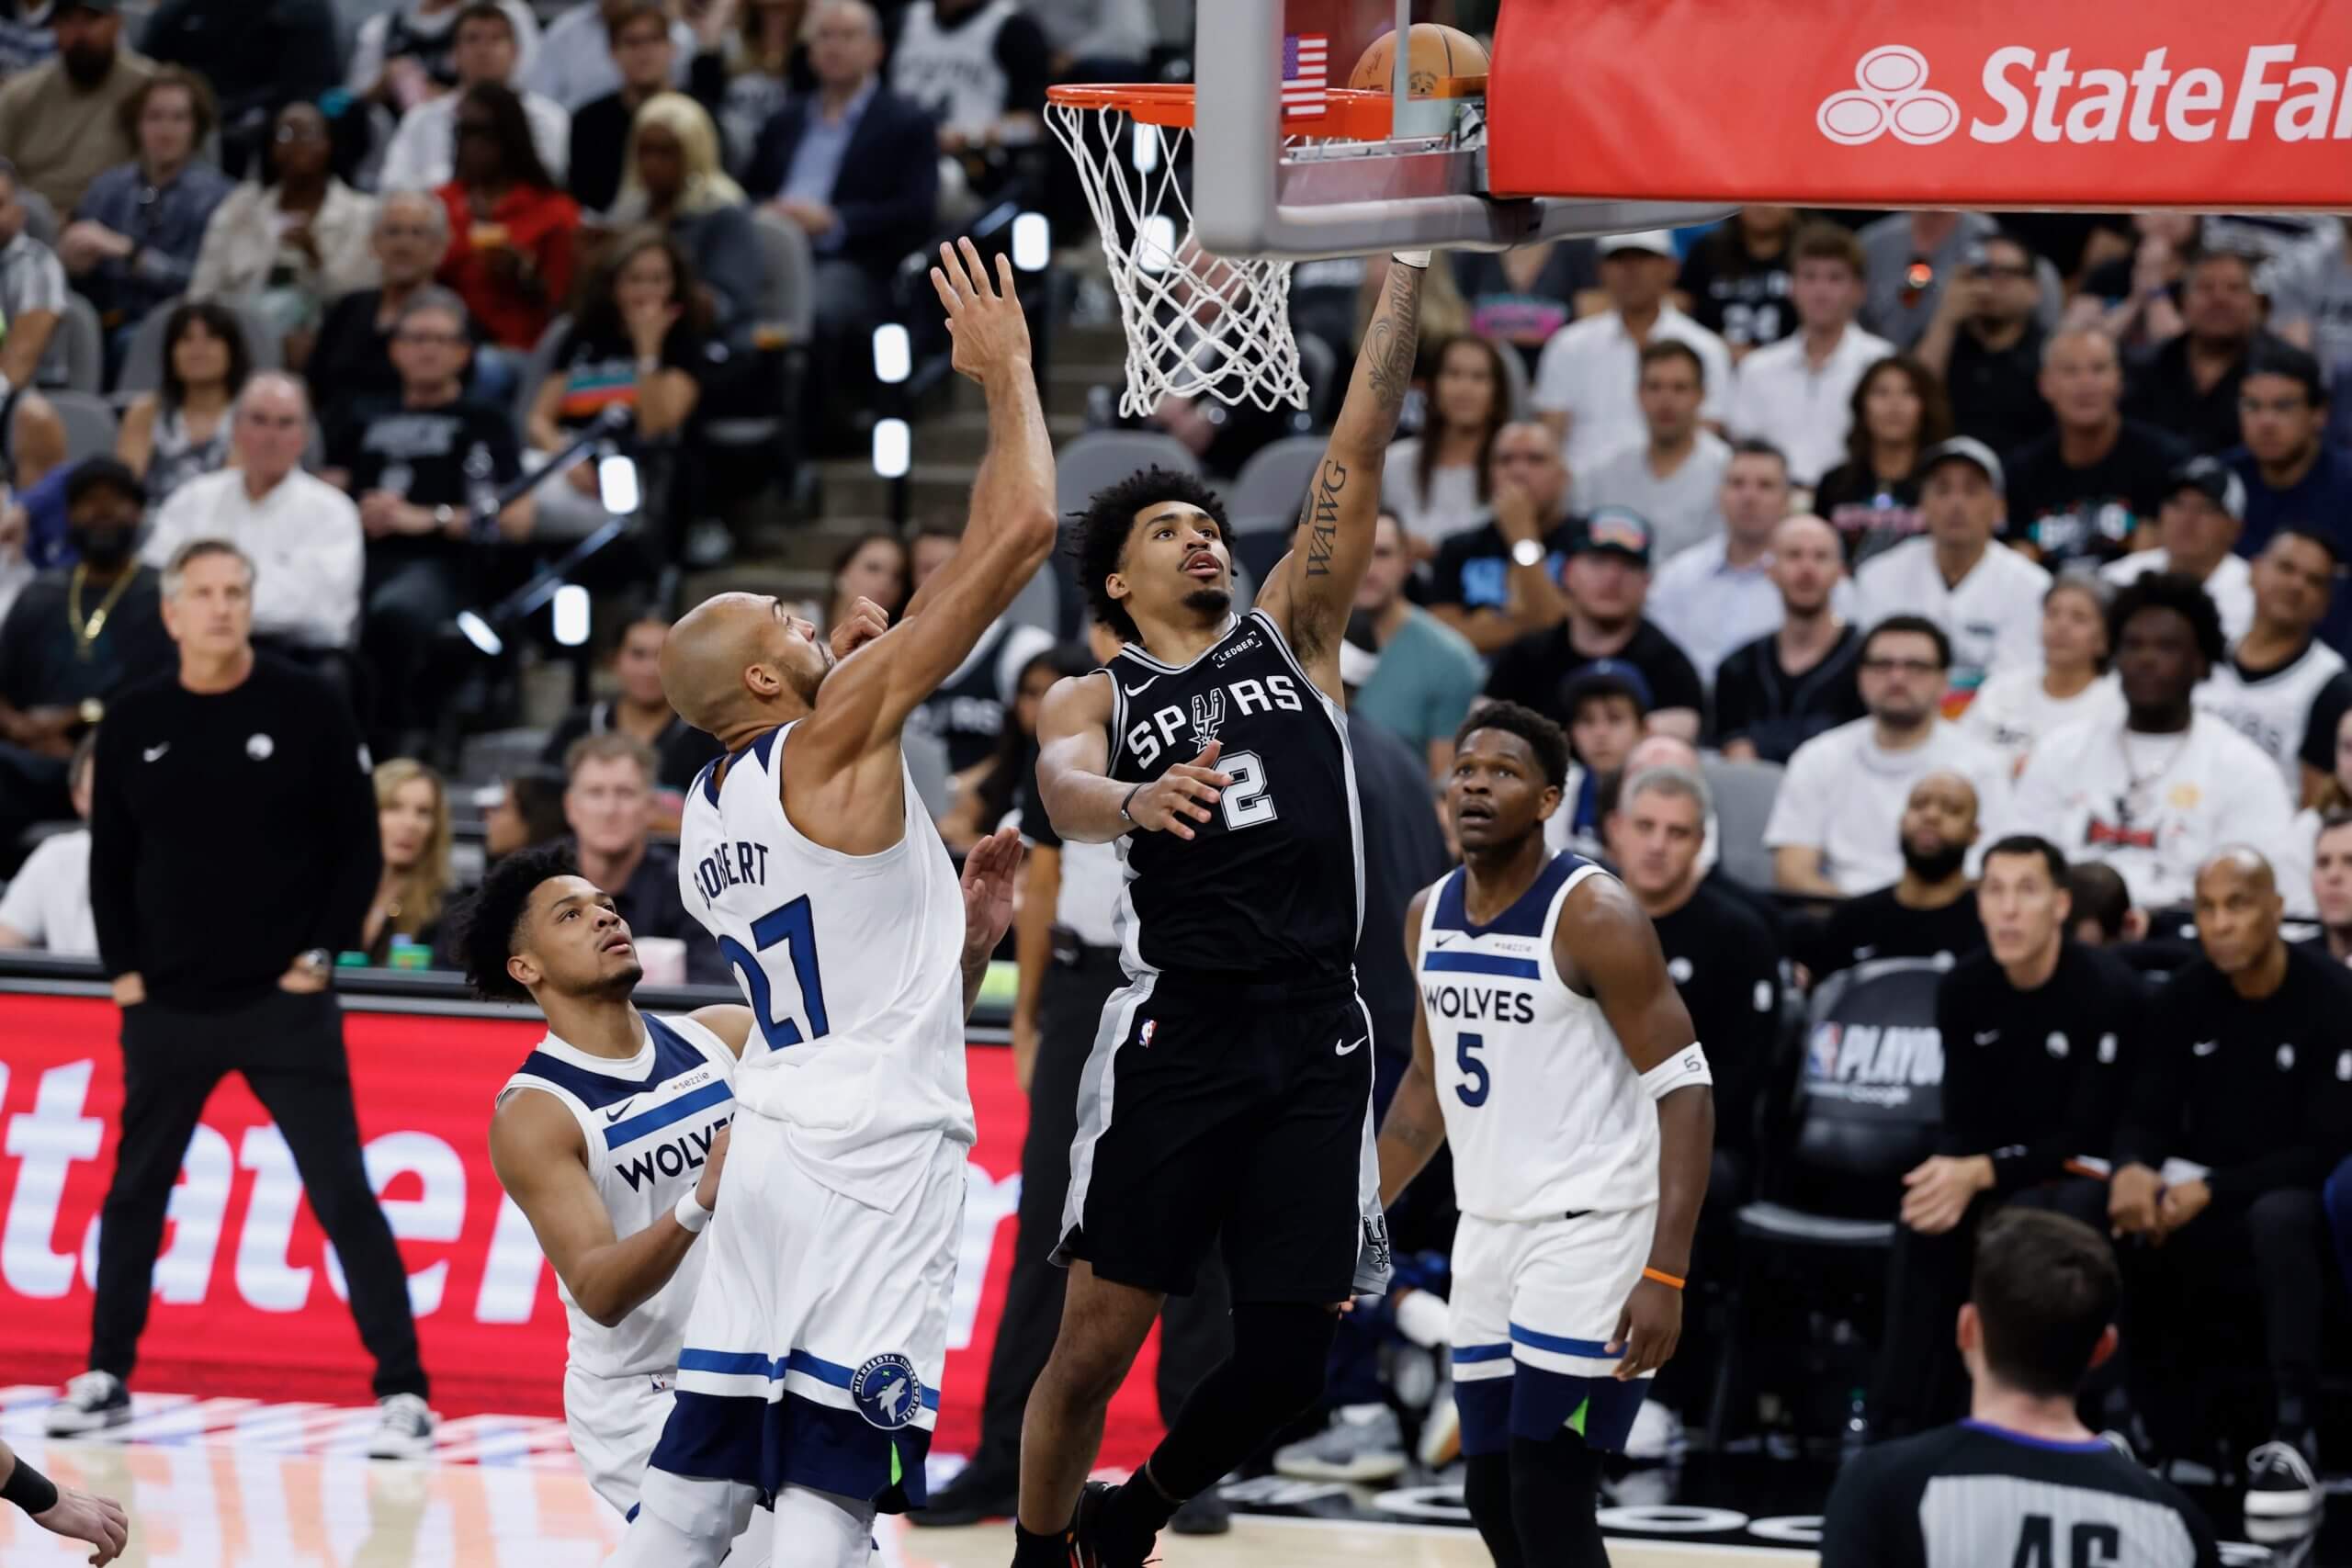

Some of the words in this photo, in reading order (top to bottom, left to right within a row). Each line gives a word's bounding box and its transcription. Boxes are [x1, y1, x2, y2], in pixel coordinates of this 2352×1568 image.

[1306, 459, 1348, 580] WAWG
[1218, 637, 1255, 662] LEDGER
[1126, 675, 1303, 770] SPURS
[1213, 750, 1279, 831] 2
[695, 840, 769, 911] GOBERT
[717, 893, 831, 1052] 27
[1423, 983, 1535, 1024] WOLVES
[679, 1071, 710, 1090] sezzle
[1454, 1032, 1490, 1108] 5
[1683, 1054, 1702, 1073] 5
[1838, 1023, 1946, 1087] PLAYO
[615, 1111, 735, 1193] WOLV
[854, 1355, 896, 1393] MINNESOTA
